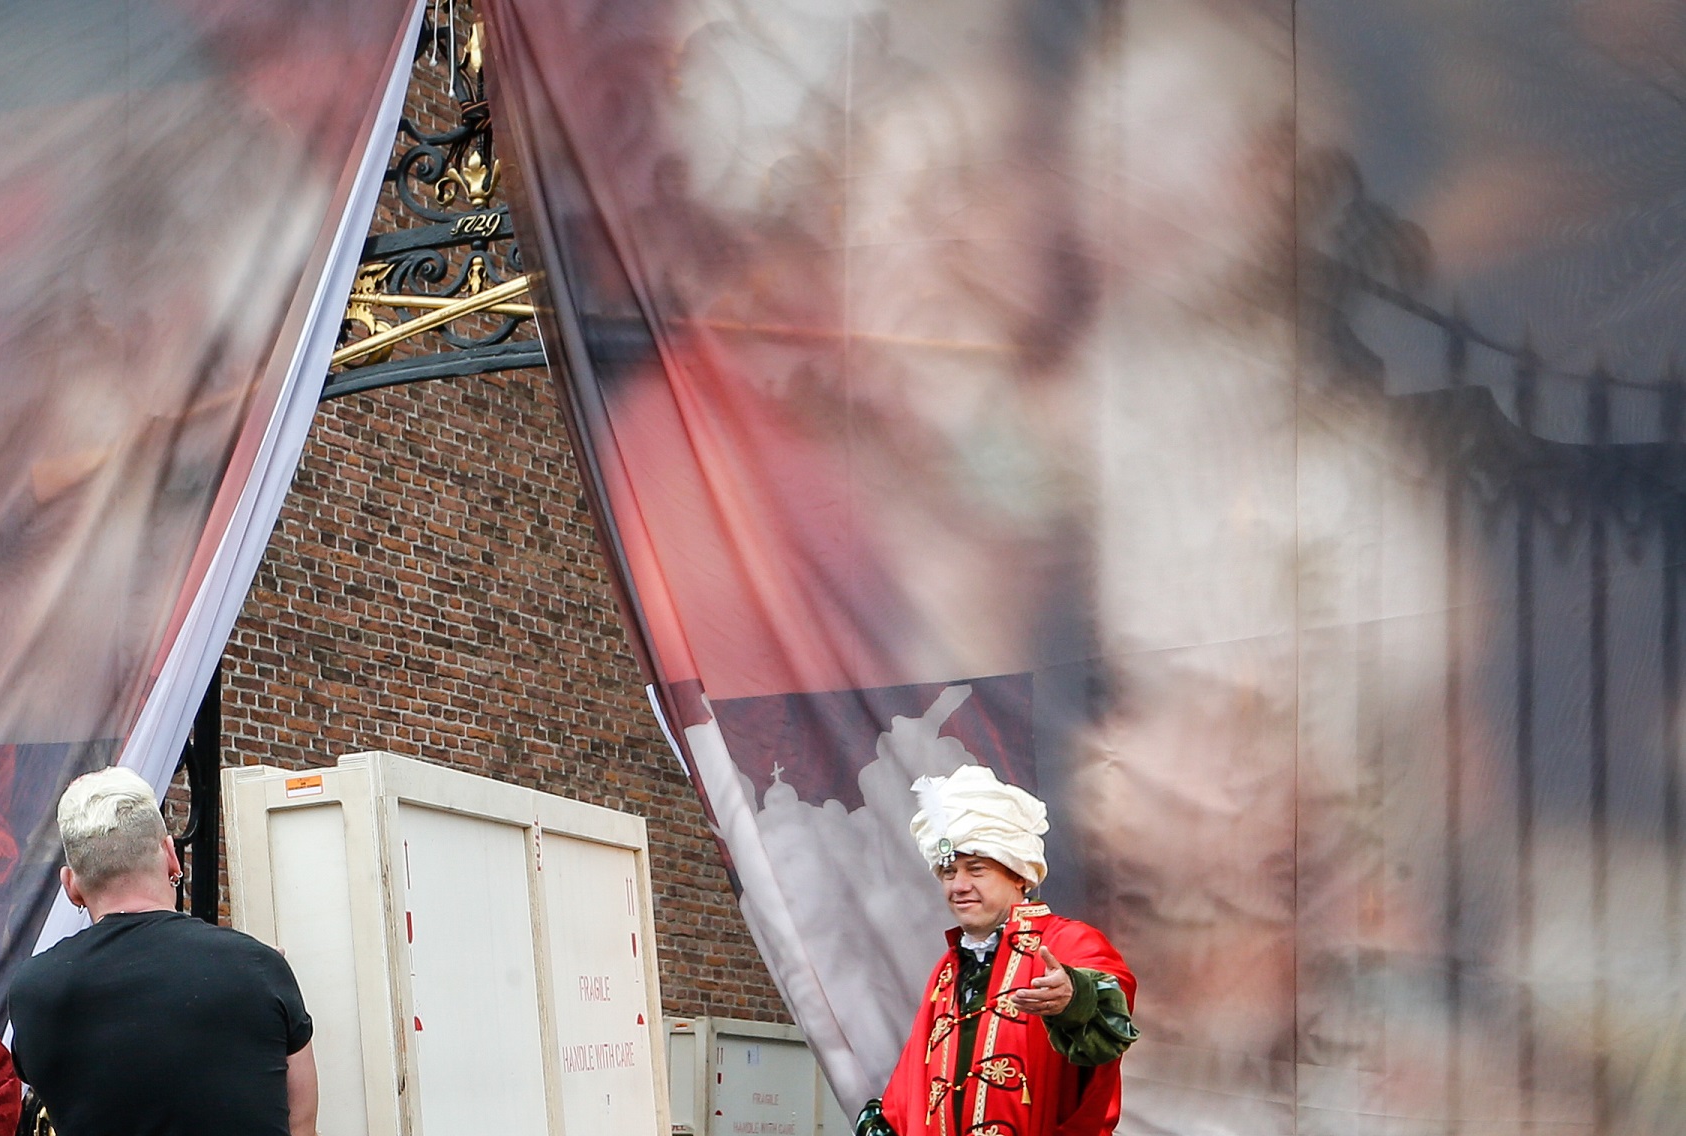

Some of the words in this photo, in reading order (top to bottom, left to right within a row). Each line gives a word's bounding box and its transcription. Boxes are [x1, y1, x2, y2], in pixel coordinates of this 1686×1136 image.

[450, 213, 501, 237] 1729
[578, 975, 611, 1002] FRAGILE
[562, 1044, 595, 1073] HANDLE
[595, 1043, 615, 1070] WITH
[615, 1041, 635, 1068] CARE
[733, 1121, 759, 1134] HANDLE
[761, 1122, 778, 1134] WITH
[778, 1123, 795, 1136] CARE
